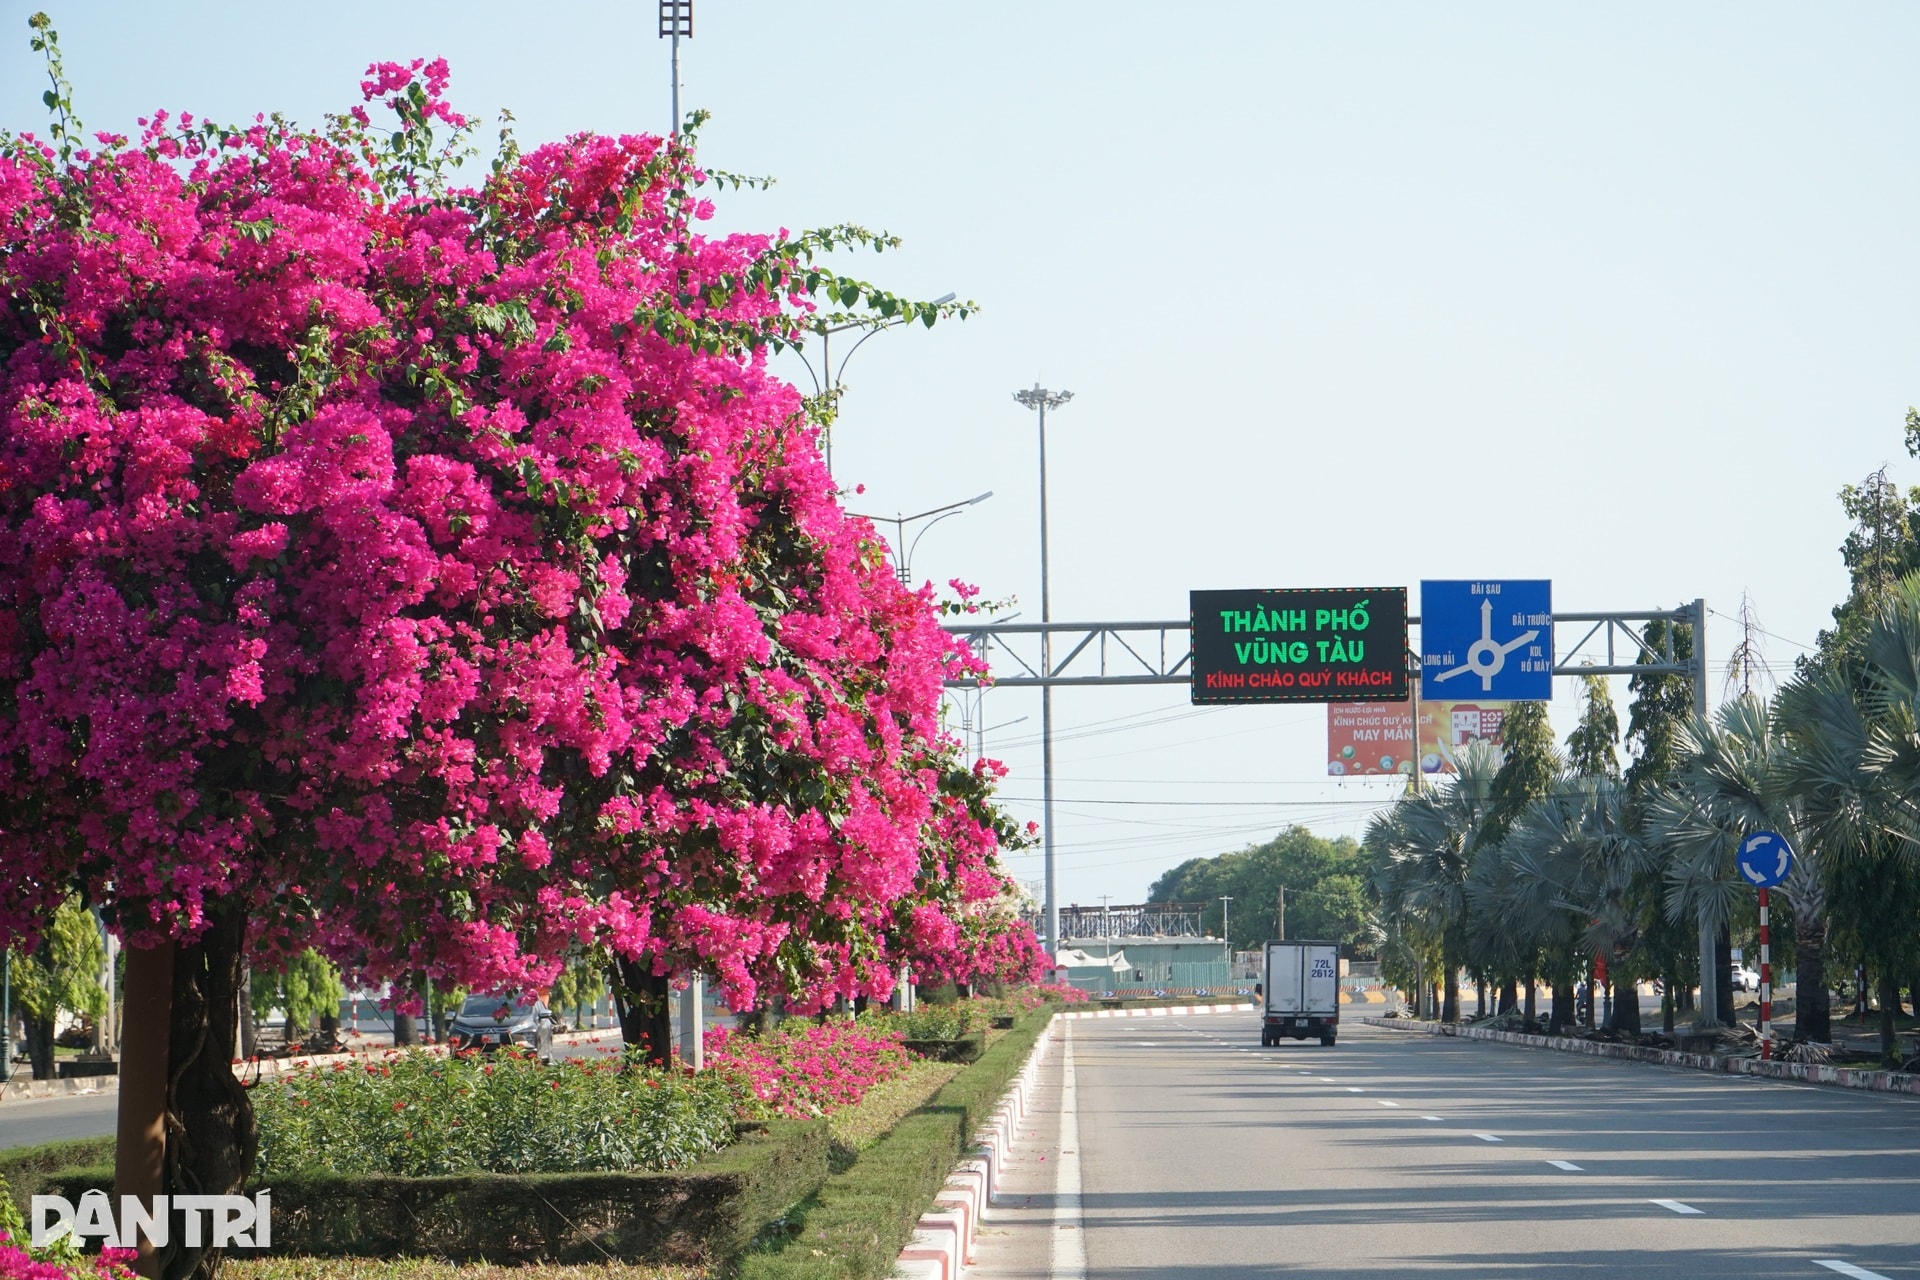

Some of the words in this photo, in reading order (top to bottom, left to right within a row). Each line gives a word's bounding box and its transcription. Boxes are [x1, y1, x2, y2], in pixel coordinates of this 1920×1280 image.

[1471, 583, 1484, 595] BÃI
[1485, 584, 1501, 595] SAU
[1220, 603, 1306, 632] THÀNH
[1315, 599, 1370, 631] PHỐ
[1527, 611, 1550, 626] TRƯỚC
[1234, 637, 1309, 665] VŨNG
[1316, 634, 1364, 663] TÀU
[1529, 645, 1543, 657] KDL
[1423, 654, 1441, 666] LONG
[1206, 670, 1244, 688] KÍNH
[1249, 669, 1294, 687] CHÀO
[1298, 668, 1331, 687] QUÝ
[1336, 668, 1392, 686] KHÁCH
[1334, 715, 1355, 726] KÍNH
[1356, 715, 1381, 726] CHÚC
[1353, 729, 1380, 741] MAY
[1383, 724, 1413, 741] MẮN
[1314, 960, 1331, 968] 72L
[1311, 969, 1334, 978] 2612
